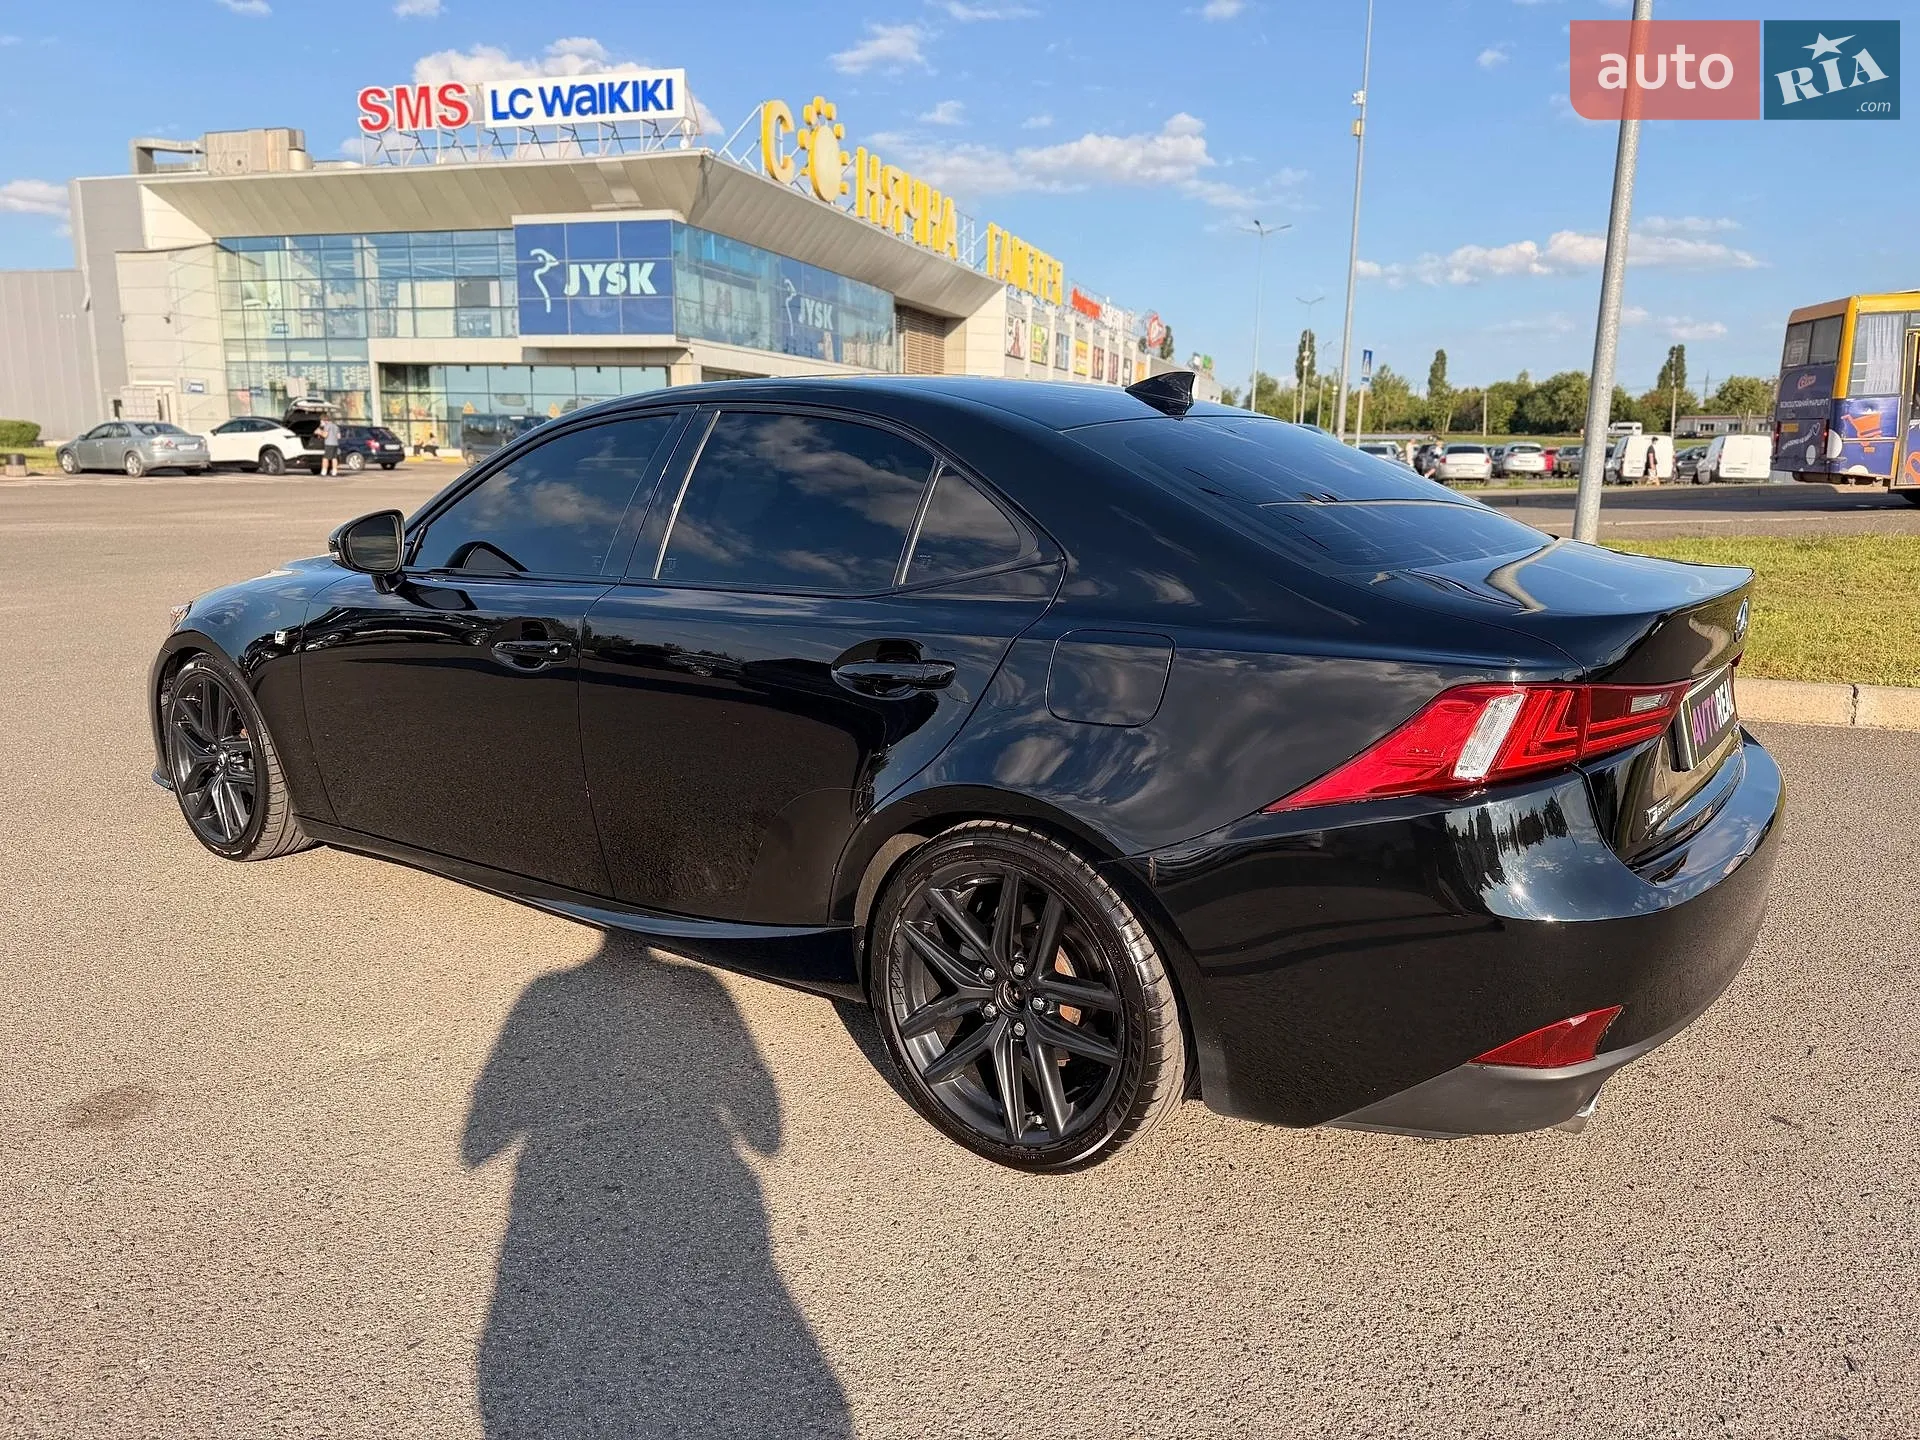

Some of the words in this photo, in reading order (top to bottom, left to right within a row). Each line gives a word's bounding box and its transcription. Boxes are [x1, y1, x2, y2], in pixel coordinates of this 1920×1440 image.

[358, 82, 471, 133] SMS
[491, 87, 533, 120] LC
[564, 262, 657, 296] JYSK
[798, 296, 834, 331] JYSK
[1693, 678, 1735, 746] AVTOREAL
